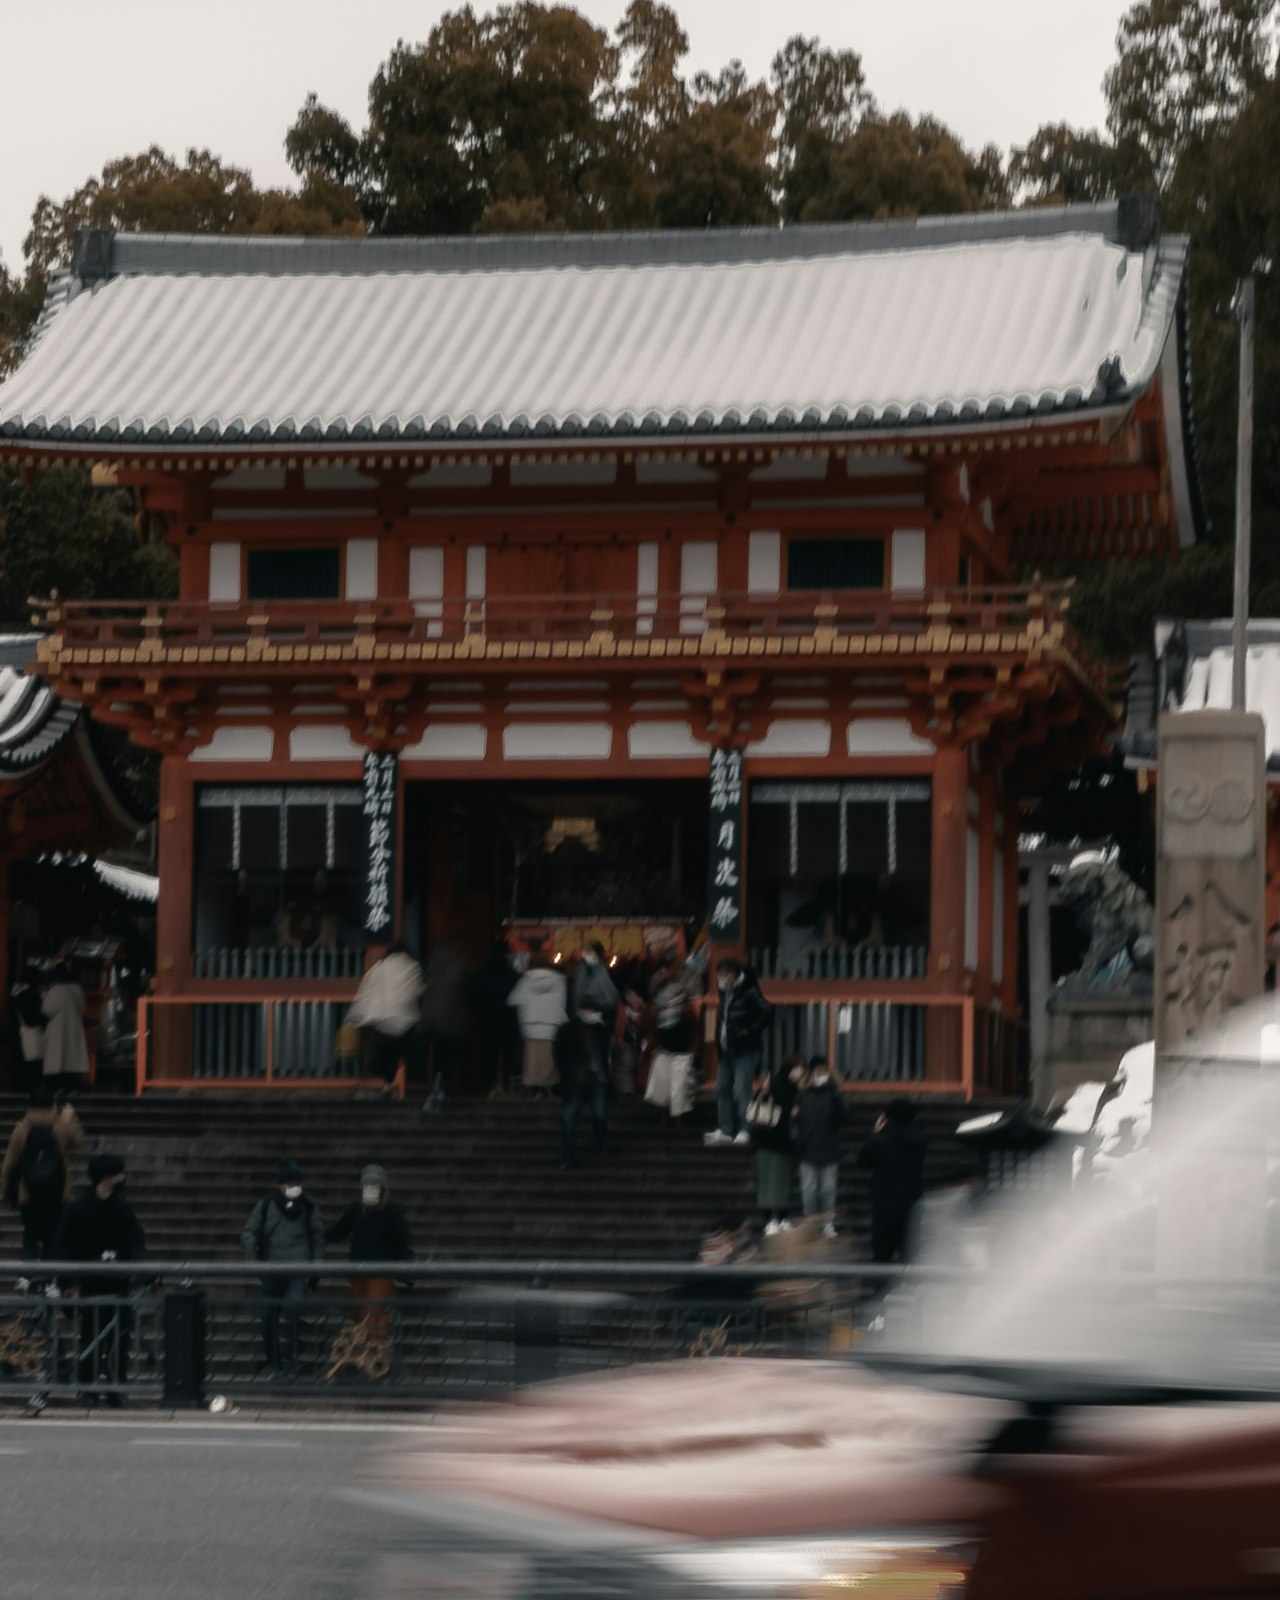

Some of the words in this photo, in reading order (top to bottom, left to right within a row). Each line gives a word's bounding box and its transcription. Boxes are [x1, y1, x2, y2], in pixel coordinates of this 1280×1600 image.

[710, 818, 740, 931] 月次祭
[1162, 877, 1252, 1042] 八坂
